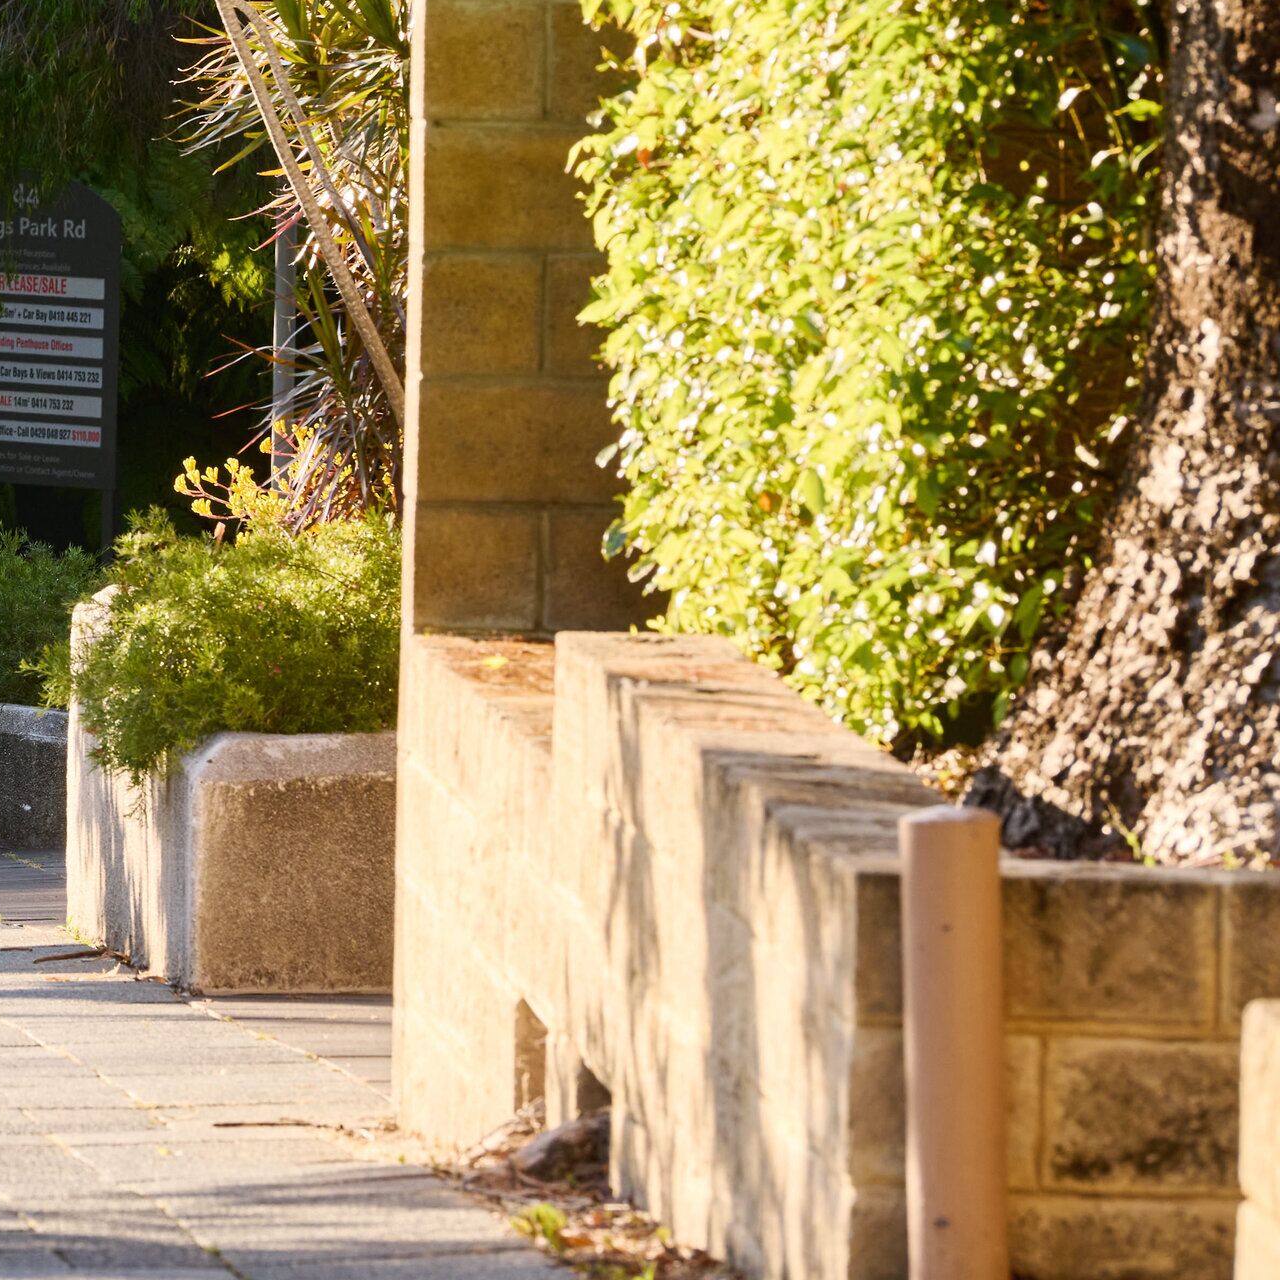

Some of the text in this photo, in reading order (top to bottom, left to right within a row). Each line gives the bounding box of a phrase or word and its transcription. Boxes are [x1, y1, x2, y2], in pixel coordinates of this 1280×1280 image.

[20, 217, 57, 238] Park
[63, 219, 86, 239] Rd
[8, 274, 67, 295] LEASE/SALE
[23, 308, 34, 320] Car
[36, 309, 47, 322] Bay
[48, 311, 65, 322] 0410
[66, 311, 78, 323] 445
[79, 312, 92, 324] 221
[16, 338, 49, 350] Penthouse
[51, 339, 73, 351] Offices
[0, 366, 11, 377] Car
[12, 367, 27, 380] Bays
[29, 369, 34, 378] &
[36, 369, 55, 380] Views
[56, 370, 73, 381] 0414
[74, 371, 86, 382] 753
[87, 372, 99, 383] 232
[31, 397, 47, 408] 0414
[49, 398, 61, 410] 753
[62, 400, 74, 411] 232
[30, 427, 46, 438] 0429
[59, 429, 71, 440] 927
[72, 430, 99, 442] $110,000
[18, 452, 32, 461] Sale
